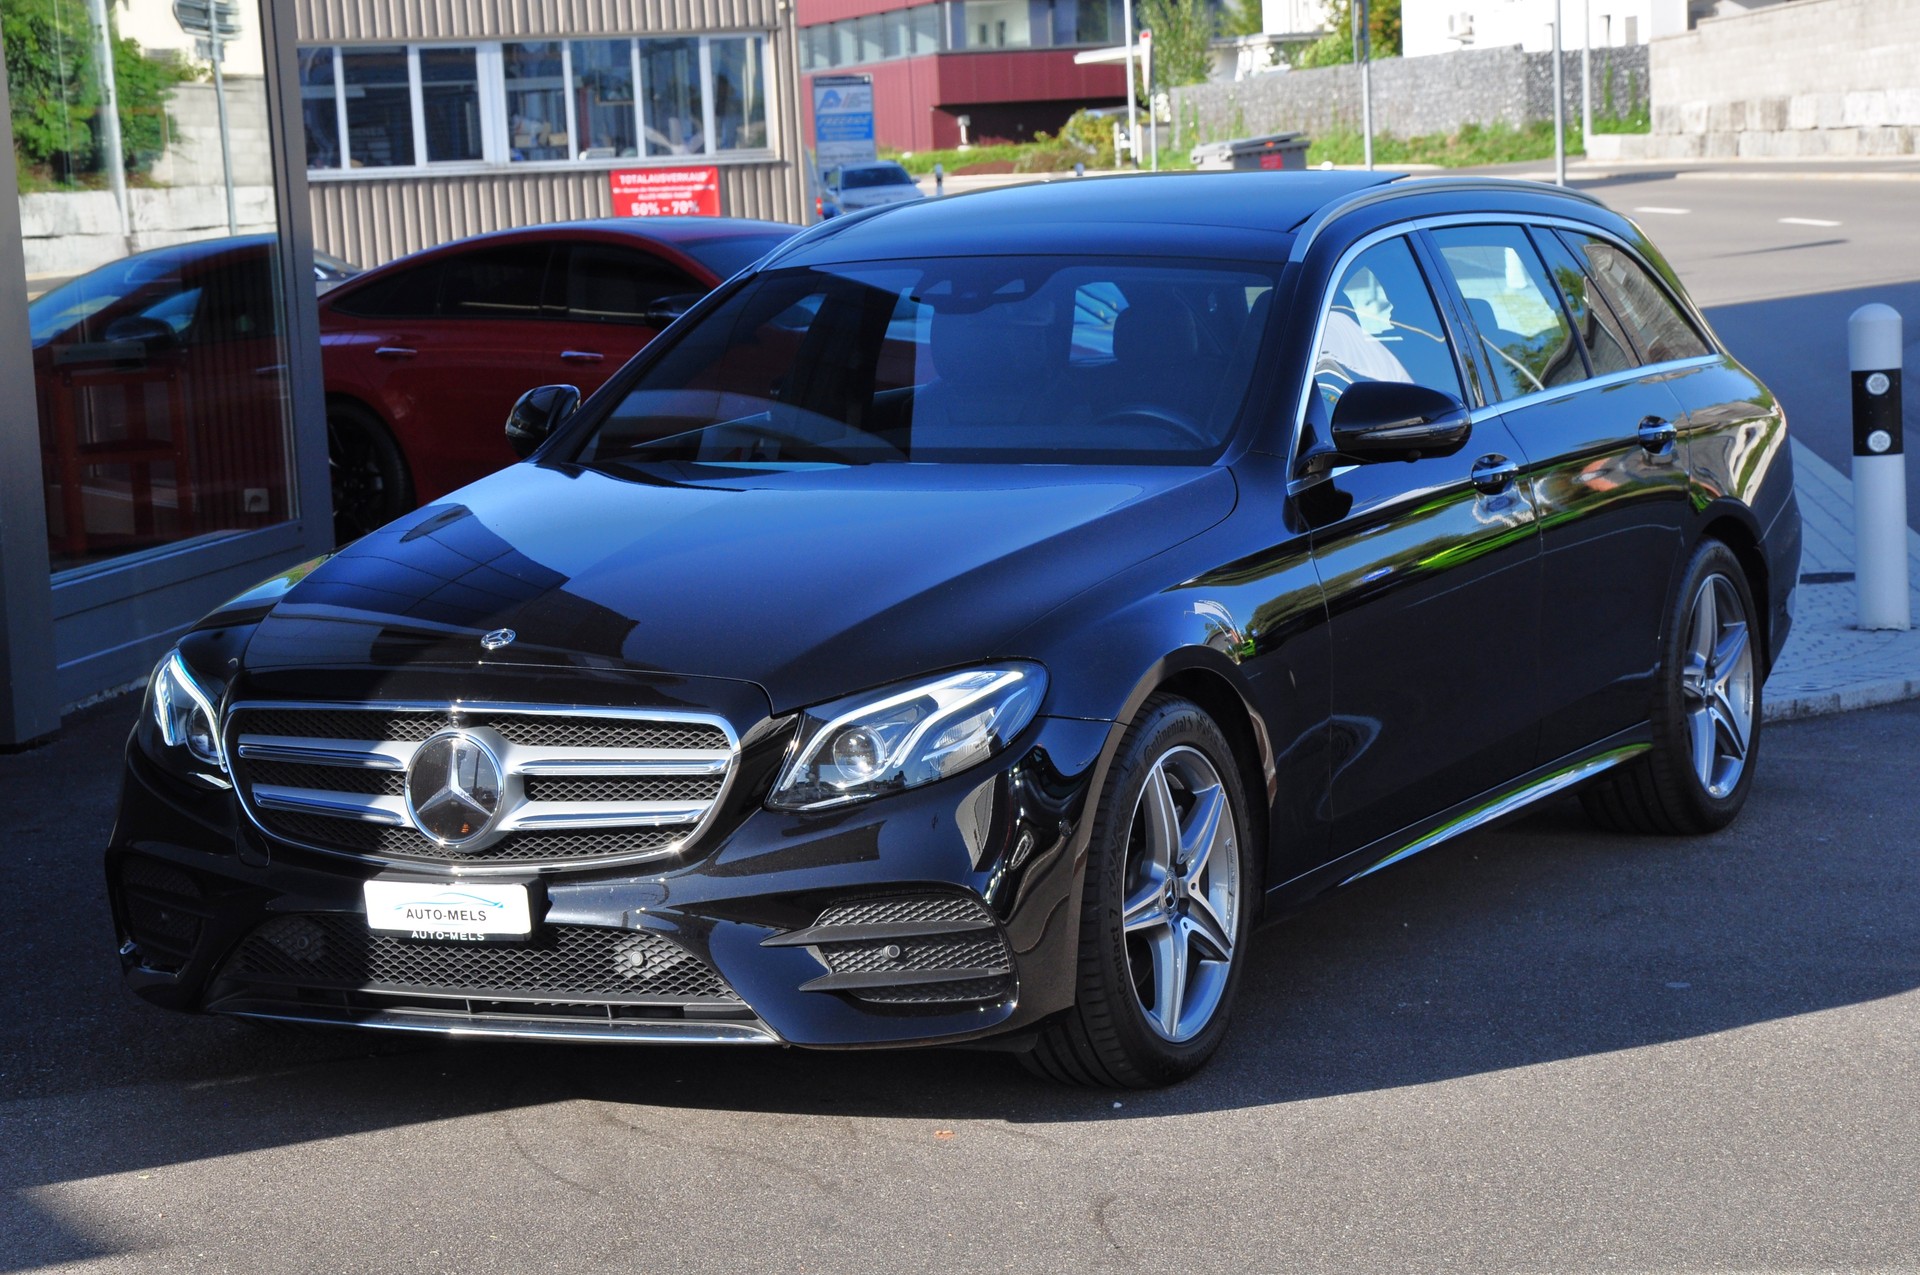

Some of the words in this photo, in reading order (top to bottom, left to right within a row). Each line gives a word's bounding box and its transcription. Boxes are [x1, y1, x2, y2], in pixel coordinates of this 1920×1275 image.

[631, 201, 660, 217] 50%
[671, 200, 700, 215] 70%
[1143, 716, 1187, 764] Continental
[406, 909, 487, 922] AUTO-MELS
[411, 930, 485, 941] AUTO-MELS
